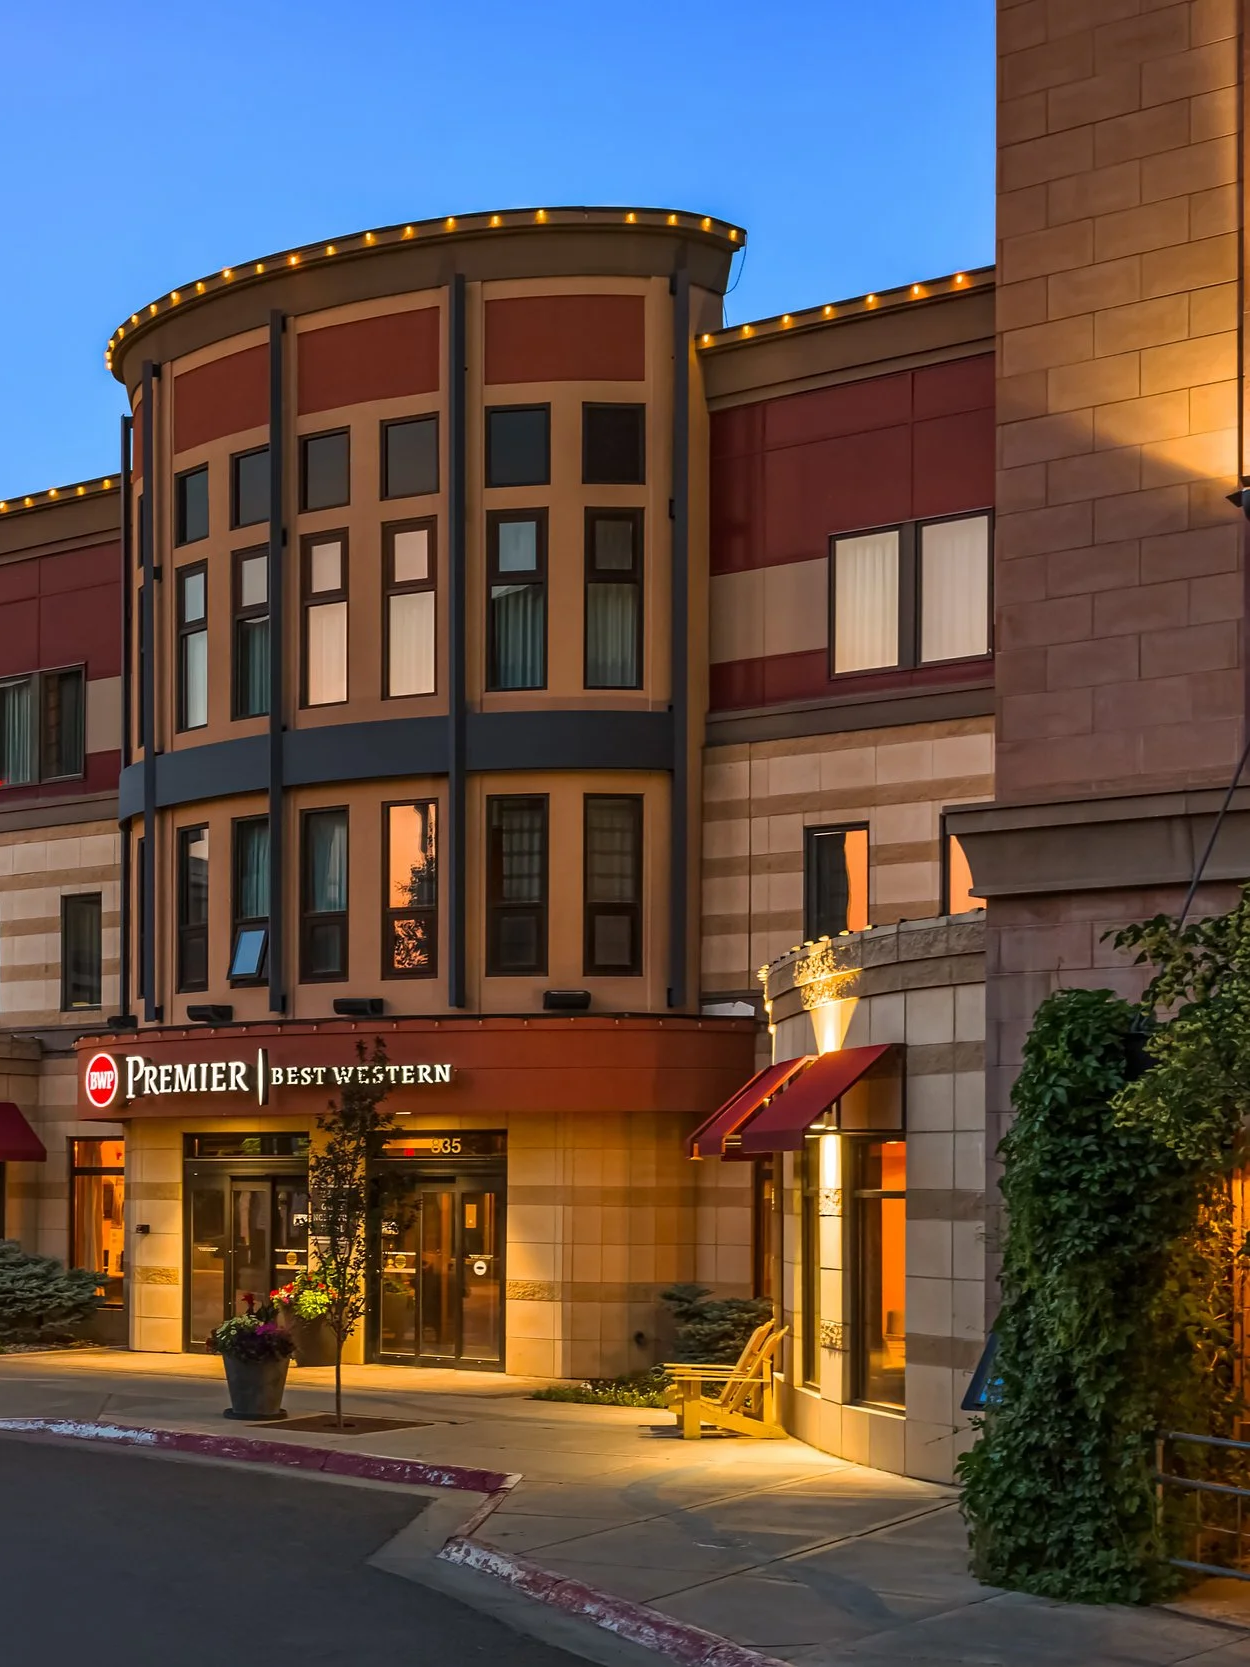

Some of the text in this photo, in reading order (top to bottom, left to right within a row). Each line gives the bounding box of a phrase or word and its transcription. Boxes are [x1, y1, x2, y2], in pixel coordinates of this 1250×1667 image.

[89, 1071, 114, 1090] BWP
[126, 1056, 452, 1099] PREMIER BEST WESTERN
[431, 1138, 461, 1154] 835
